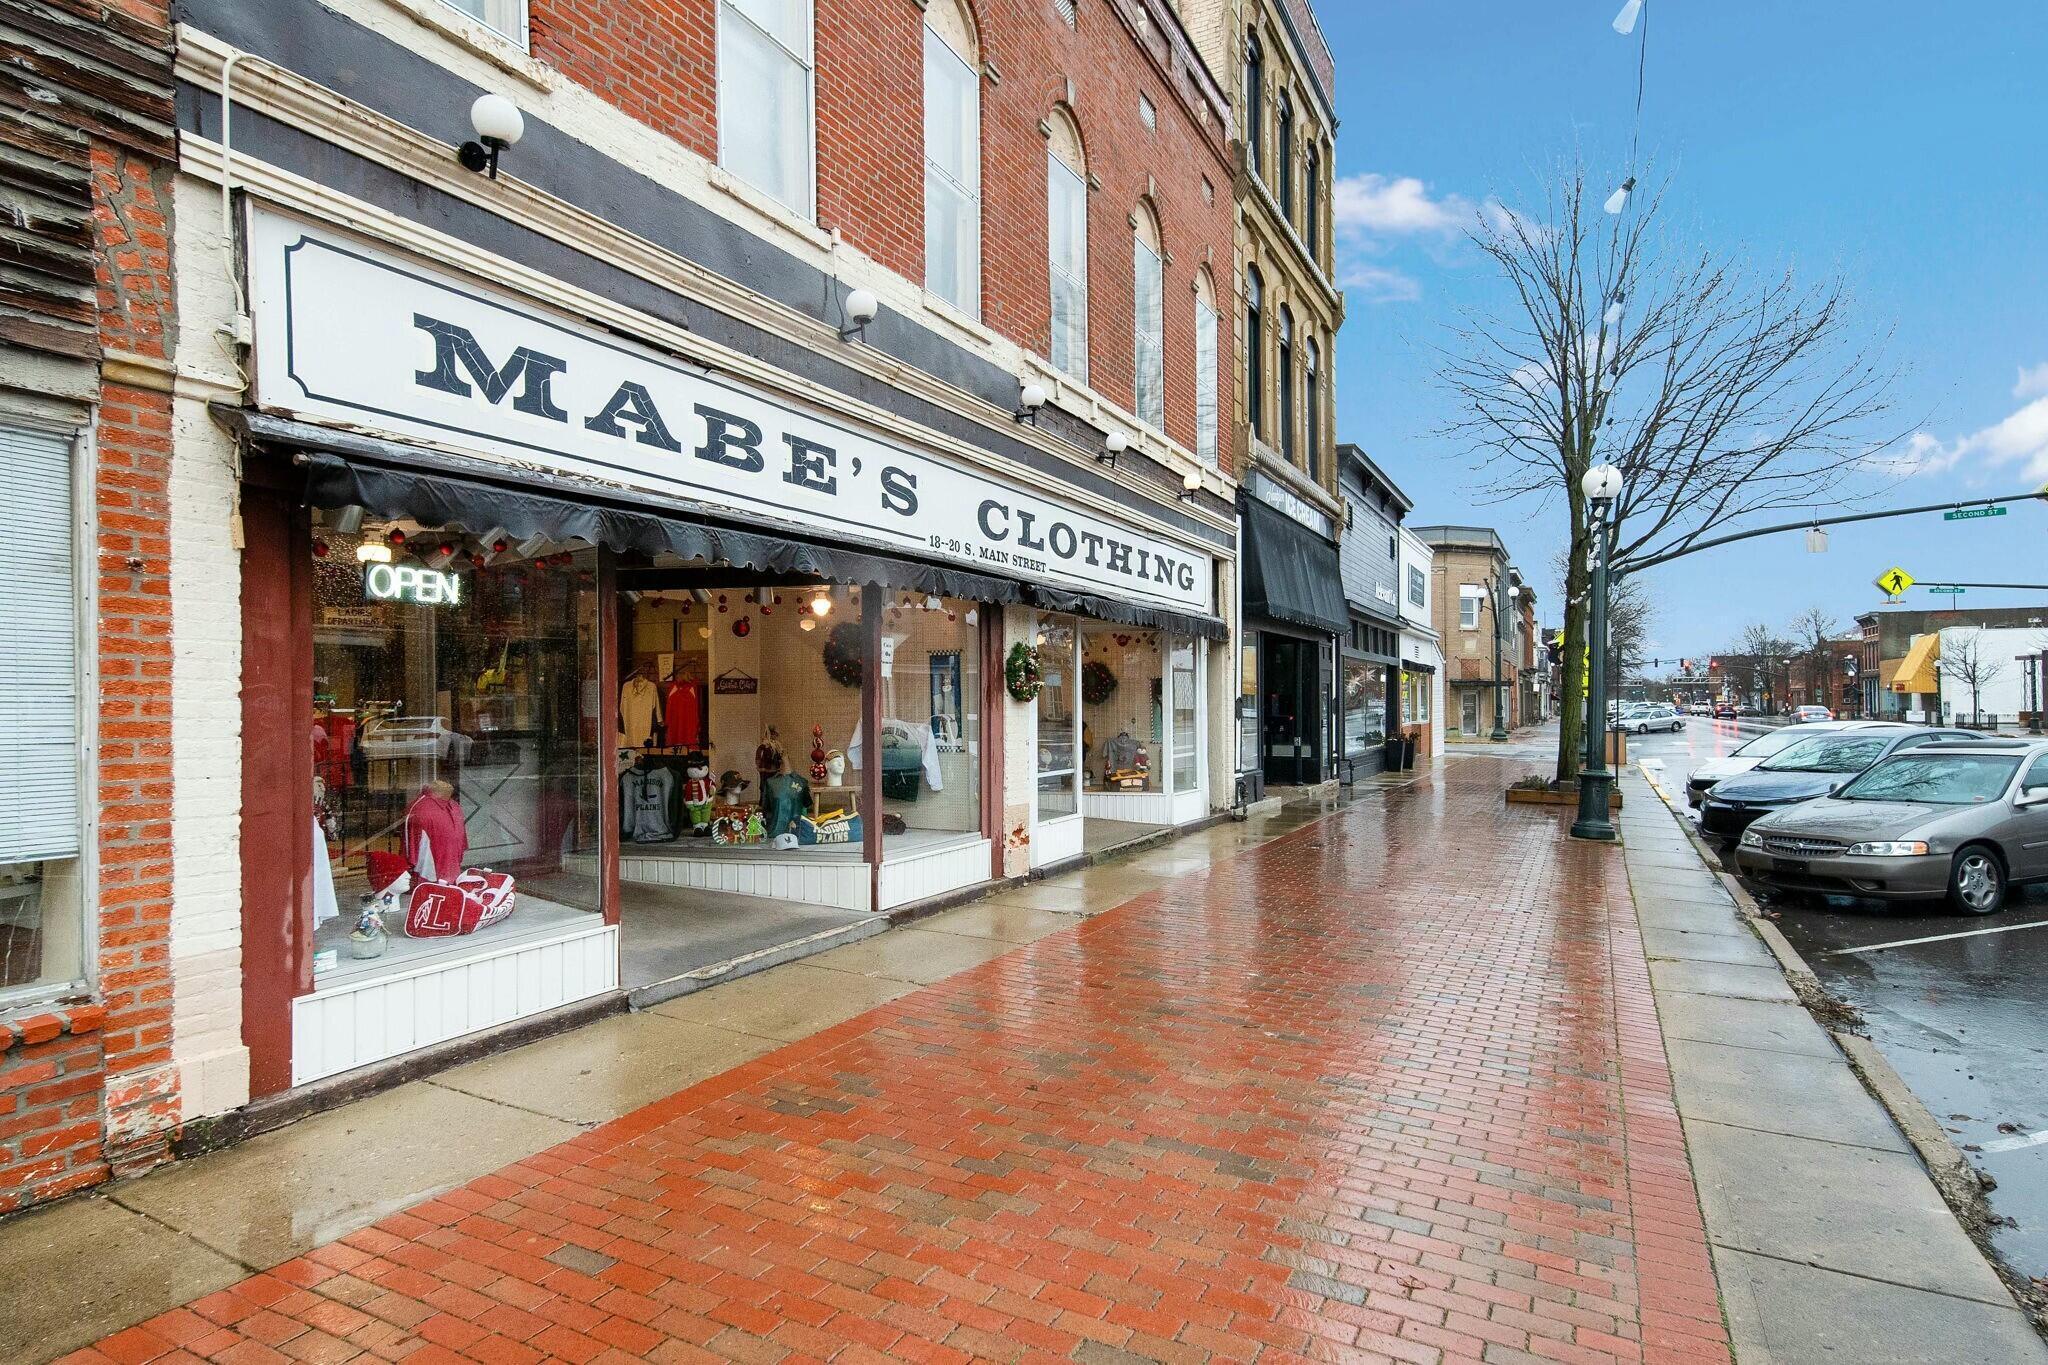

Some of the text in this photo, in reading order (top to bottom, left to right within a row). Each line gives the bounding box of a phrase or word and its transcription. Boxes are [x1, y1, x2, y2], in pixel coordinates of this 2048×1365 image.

[412, 312, 1195, 592] MABE'S CLOTHING
[1285, 492, 1297, 518] ICE
[1296, 499, 1320, 532] CREAM
[1952, 508, 1998, 519] SECOND ST
[964, 540, 976, 557] S.
[979, 546, 1009, 565] MAIN
[1012, 554, 1047, 574] STREET
[368, 563, 460, 605] OPEN
[816, 831, 849, 844] PLAINS
